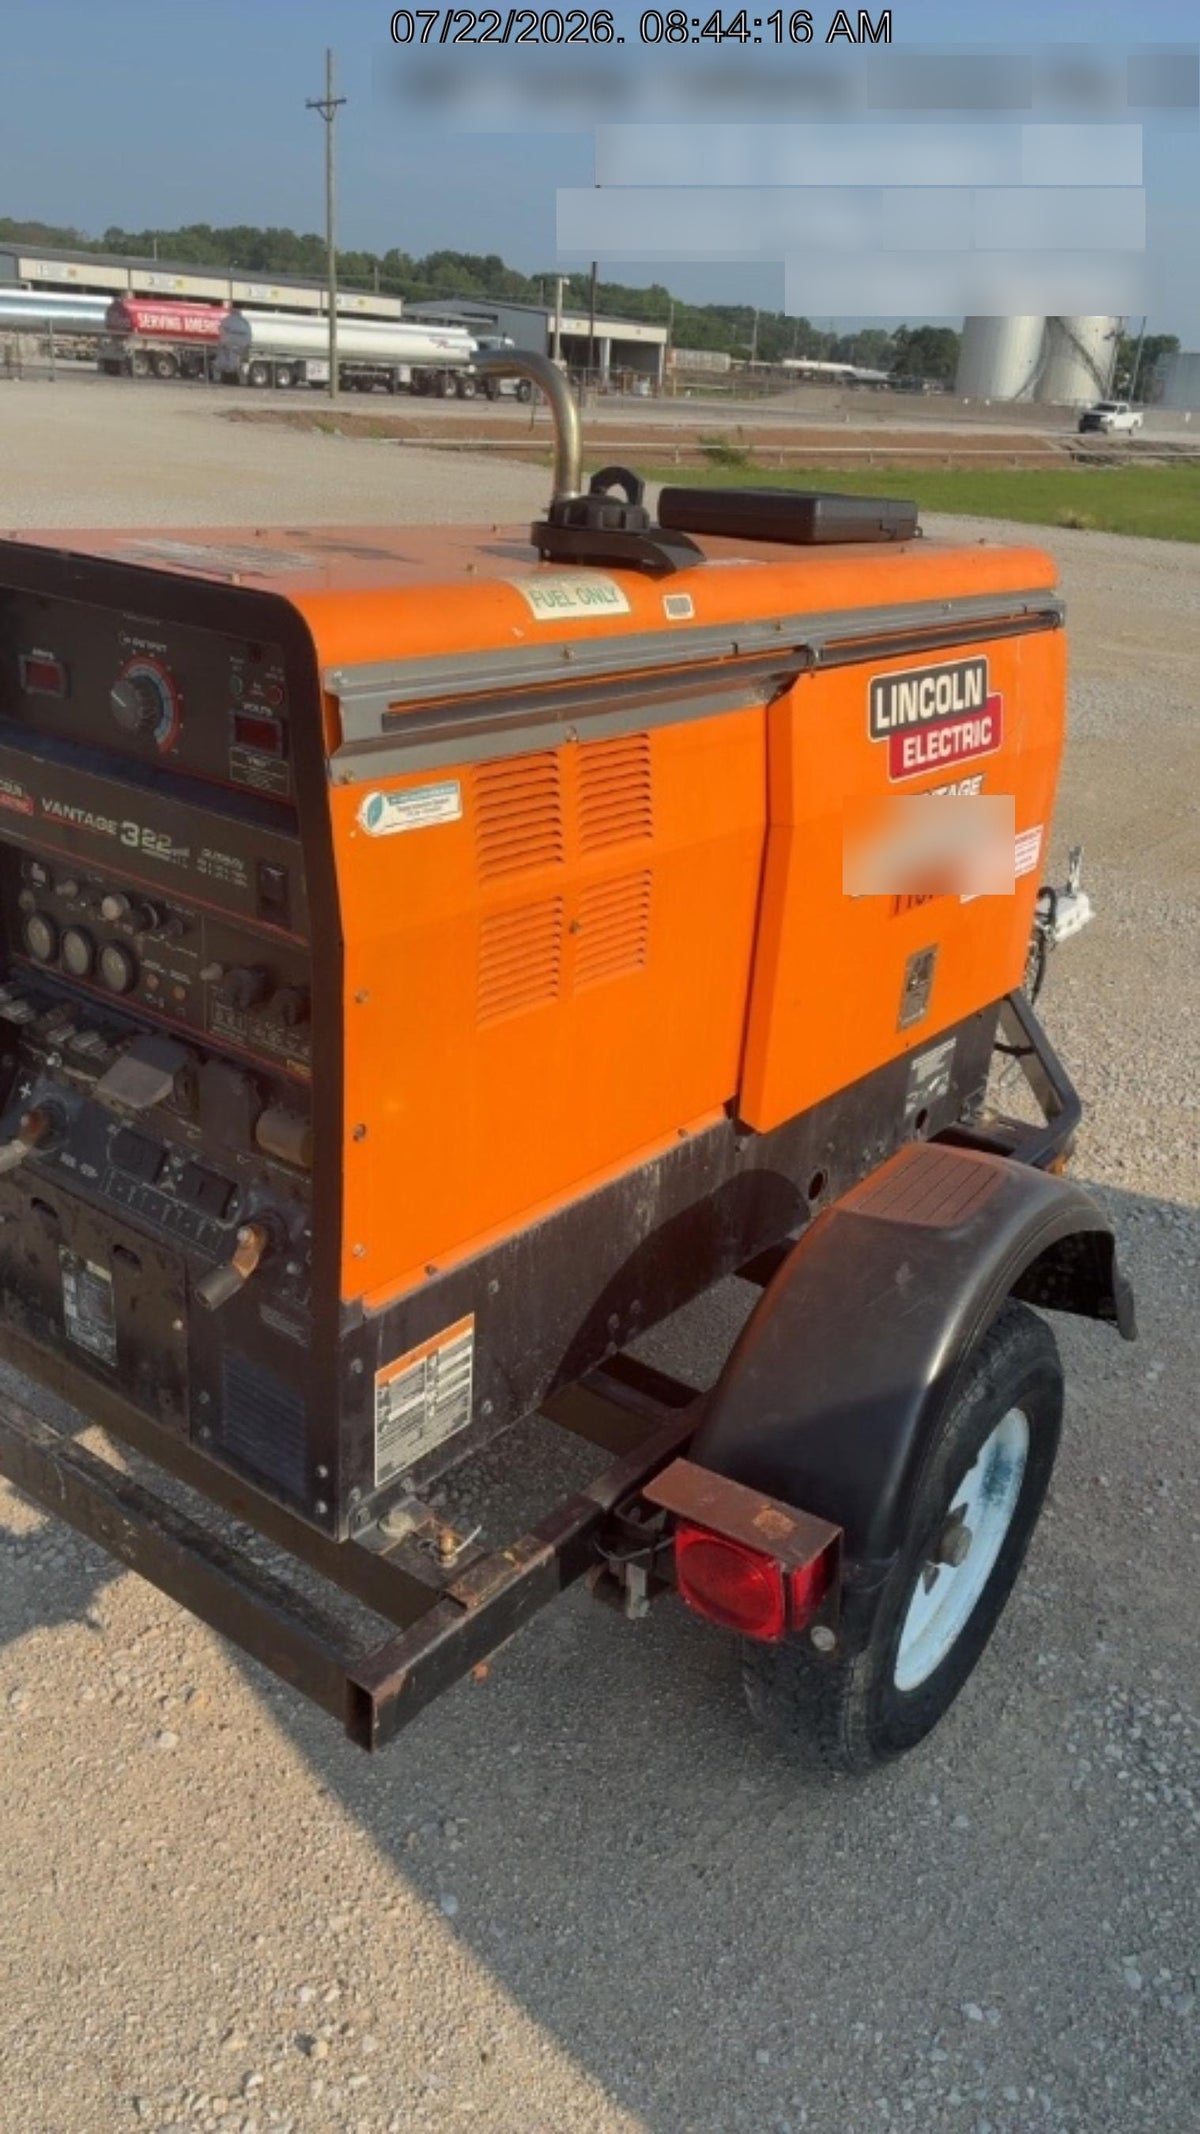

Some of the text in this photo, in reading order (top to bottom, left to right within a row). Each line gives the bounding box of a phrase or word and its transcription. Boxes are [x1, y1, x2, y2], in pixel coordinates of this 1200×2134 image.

[137, 312, 182, 331] SERVING
[528, 587, 619, 608] FUEL ONLY
[876, 668, 983, 729] LINCOLN
[903, 716, 993, 768] ELECTRIC
[41, 798, 118, 835] VANTAGE
[119, 821, 173, 852] 322
